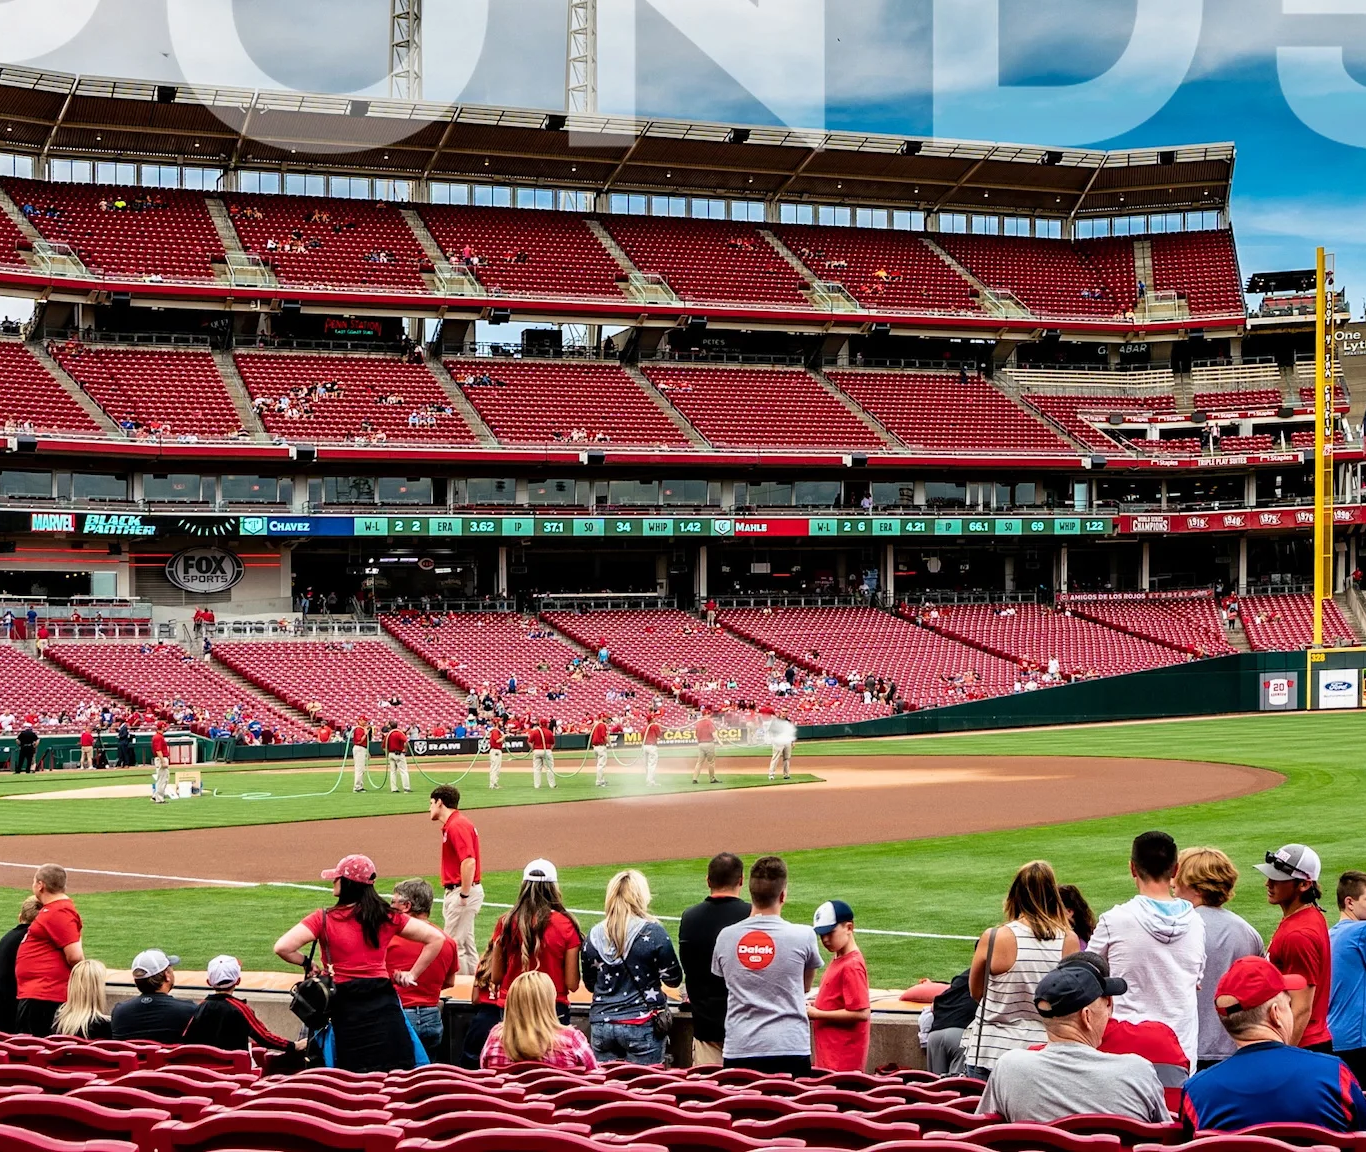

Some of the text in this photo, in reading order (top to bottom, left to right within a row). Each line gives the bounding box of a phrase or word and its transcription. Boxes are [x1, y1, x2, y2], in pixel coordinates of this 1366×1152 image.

[325, 318, 381, 336] PENN STATION
[1334, 331, 1361, 341] One
[1158, 454, 1294, 468] Staples Staples
[31, 513, 74, 532] MARVEL
[85, 514, 142, 525] BLACK
[83, 524, 156, 536] PANTHER
[269, 520, 668, 533] CHAVEZ 2 ERA 3.62 34 WHIP
[735, 521, 1076, 533] MAHLE ERA 69 WHIP
[1133, 521, 1168, 532] CHAMPIONS
[183, 555, 227, 575] FOX
[183, 575, 229, 583] SPORTS
[1311, 653, 1326, 662] 328
[1273, 683, 1284, 691] 20
[1328, 682, 1348, 691] Ford
